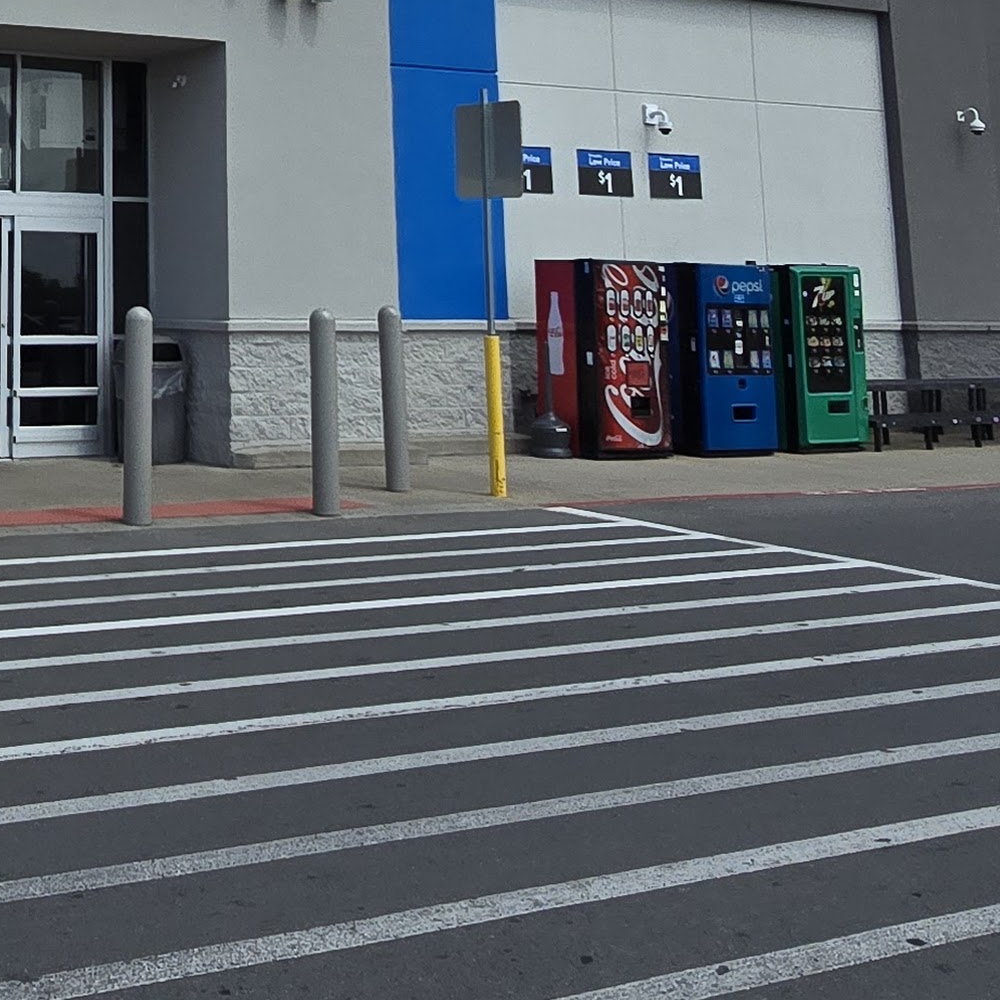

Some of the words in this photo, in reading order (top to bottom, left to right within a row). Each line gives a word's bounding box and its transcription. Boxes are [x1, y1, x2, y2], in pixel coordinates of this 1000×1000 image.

[522, 168, 533, 191] 1
[597, 169, 613, 194] $1
[669, 173, 684, 197] $1
[731, 278, 764, 295] pepsi
